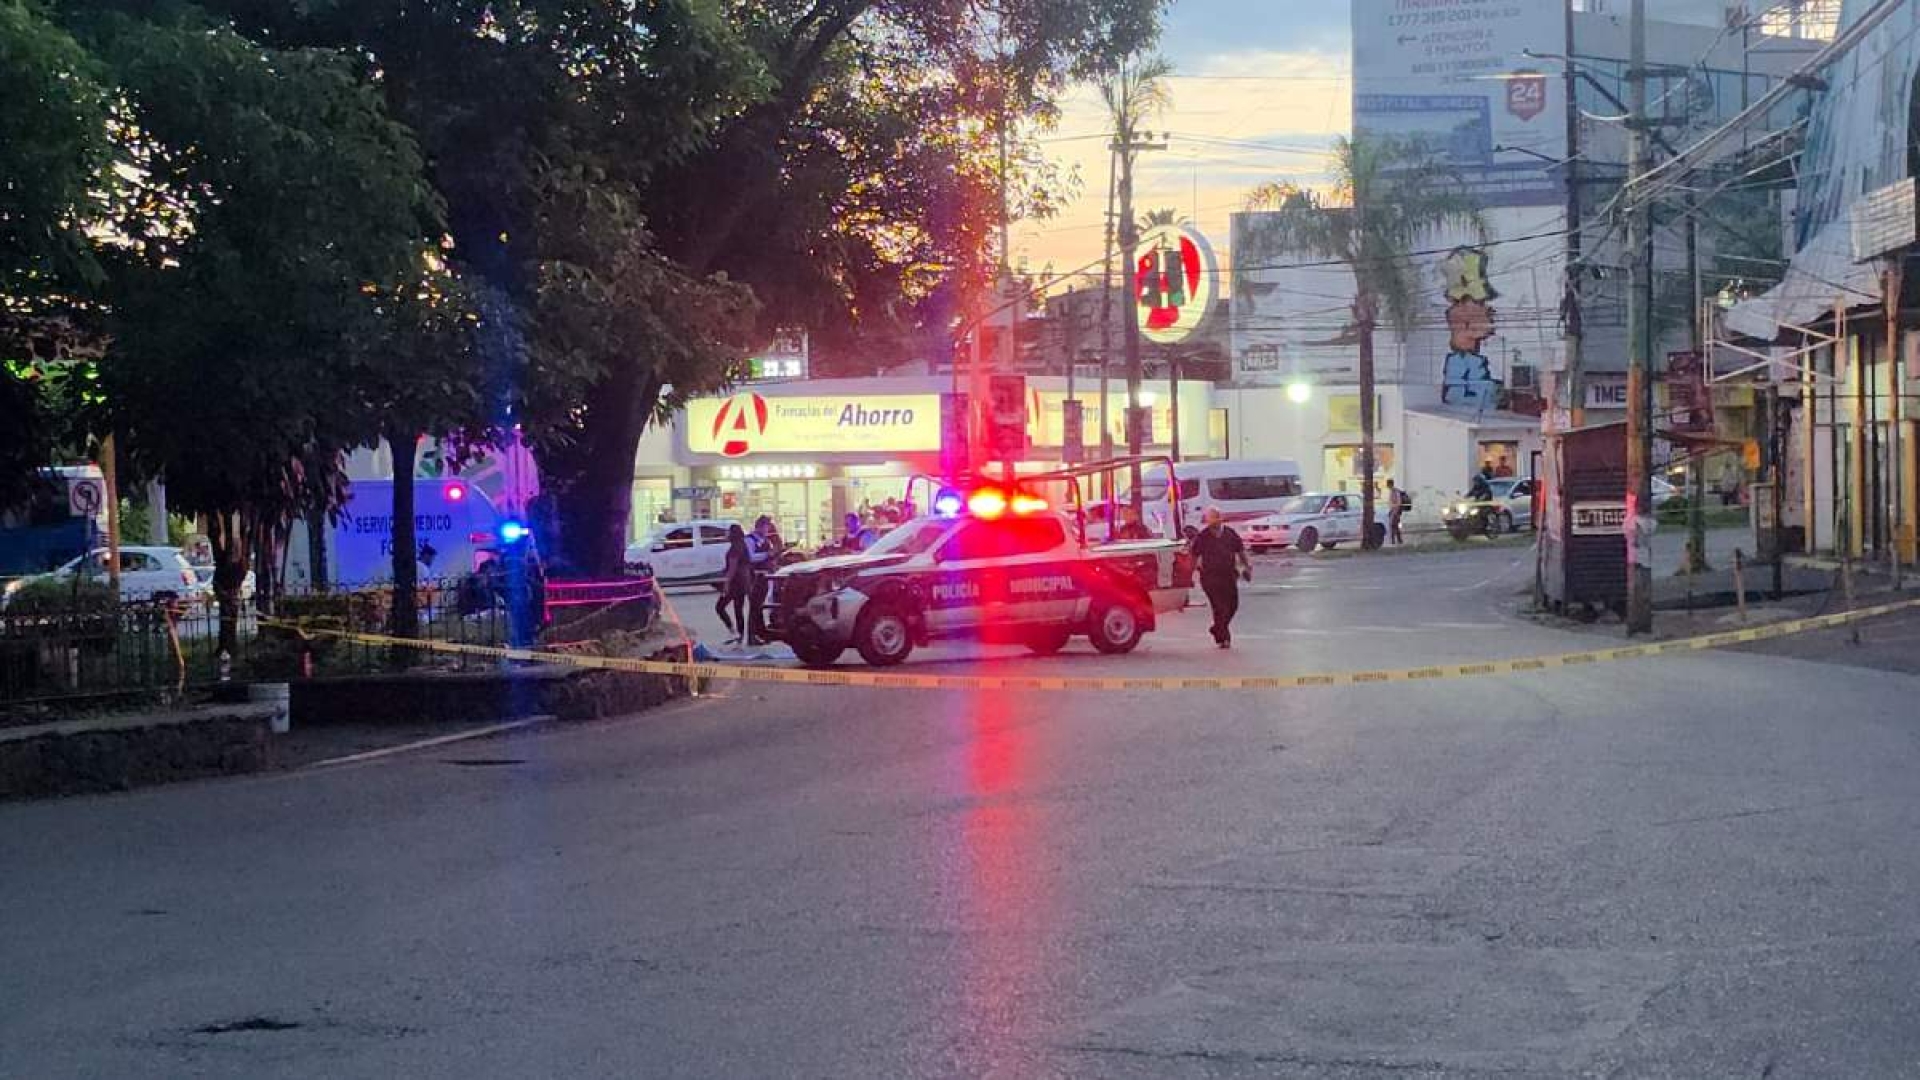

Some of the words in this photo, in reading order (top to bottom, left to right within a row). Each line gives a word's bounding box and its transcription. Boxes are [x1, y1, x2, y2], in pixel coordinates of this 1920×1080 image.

[1511, 84, 1540, 102] 24
[837, 403, 914, 426] Ahorro
[1010, 575, 1074, 593] MUNICIPAL
